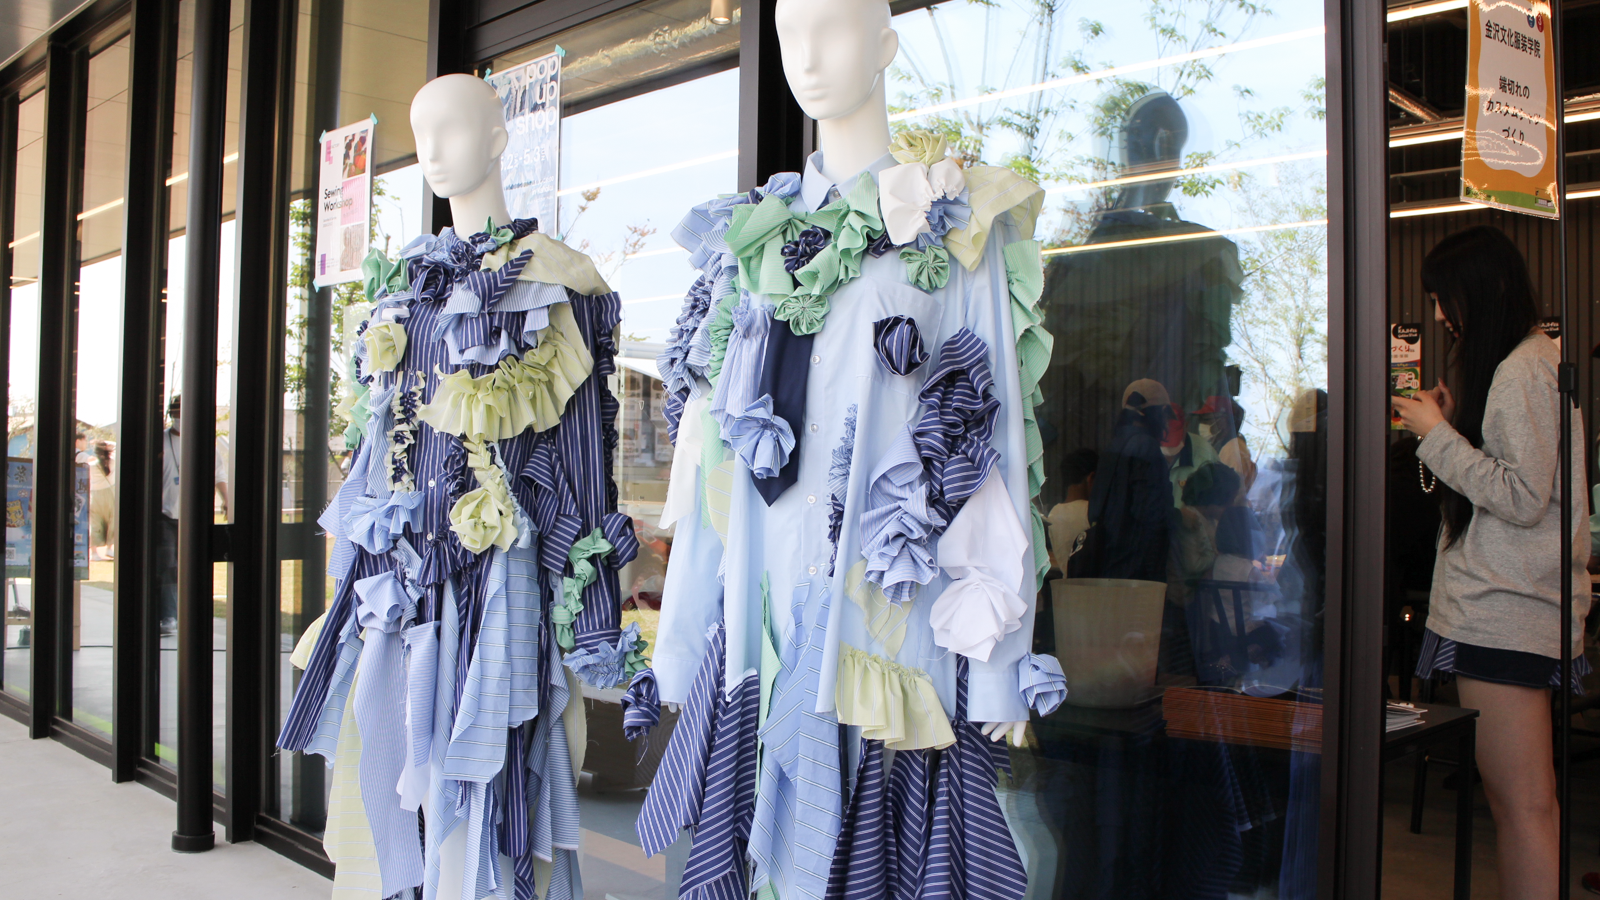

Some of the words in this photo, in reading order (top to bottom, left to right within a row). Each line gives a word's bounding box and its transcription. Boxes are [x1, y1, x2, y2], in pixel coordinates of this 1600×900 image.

[1485, 19, 1541, 58] 金沢文化服装学院
[526, 56, 559, 90] pop
[537, 80, 558, 108] up
[1499, 75, 1530, 100] 端切れの
[515, 106, 558, 136] shop
[1502, 126, 1525, 146] づくり
[323, 185, 344, 200] Sewing
[323, 197, 353, 213] Workshop
